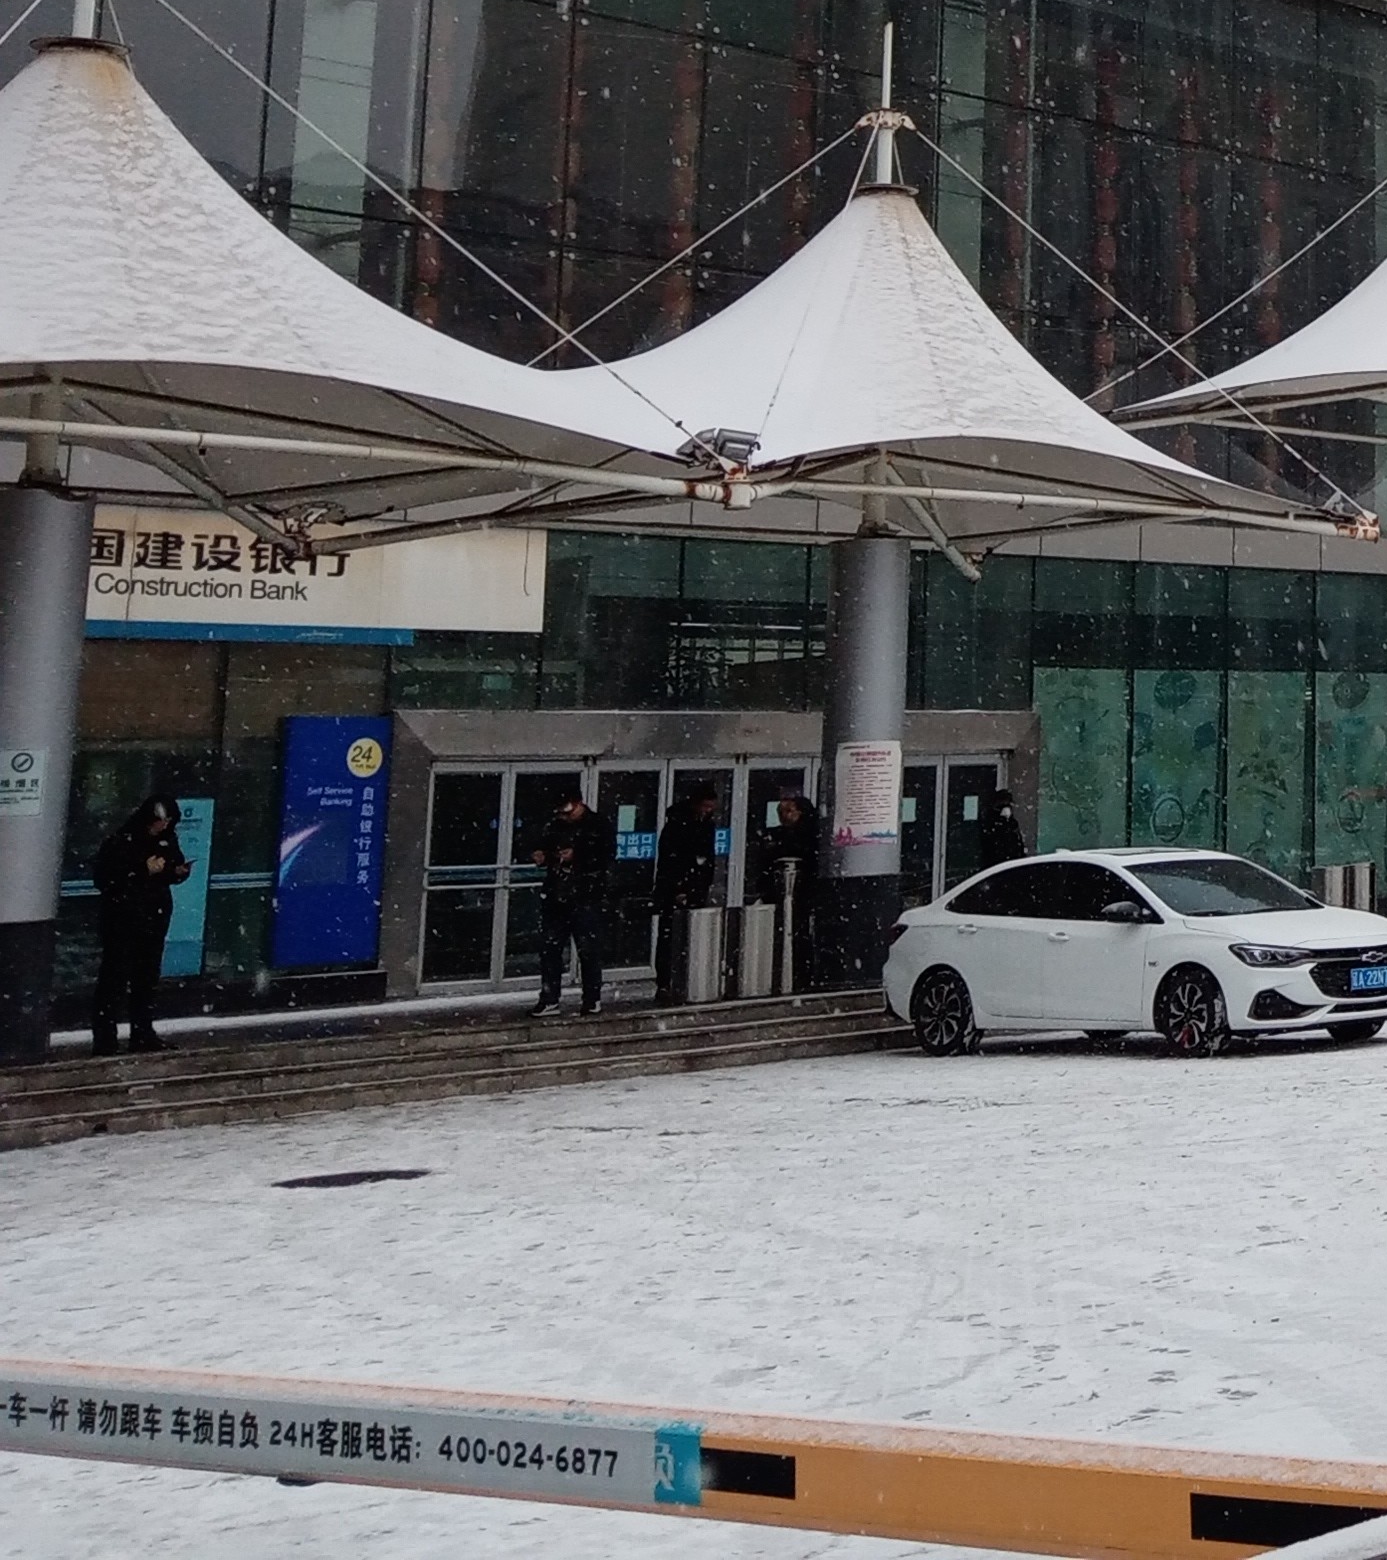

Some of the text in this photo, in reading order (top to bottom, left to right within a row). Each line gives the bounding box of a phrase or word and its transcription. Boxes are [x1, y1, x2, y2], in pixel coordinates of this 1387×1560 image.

[94, 573, 308, 601] Construction Bank
[351, 745, 373, 763] 24
[77, 1398, 162, 1440] 请勿跟车
[171, 1406, 260, 1449] 车损自负
[438, 1435, 618, 1477] 400-024-6877
